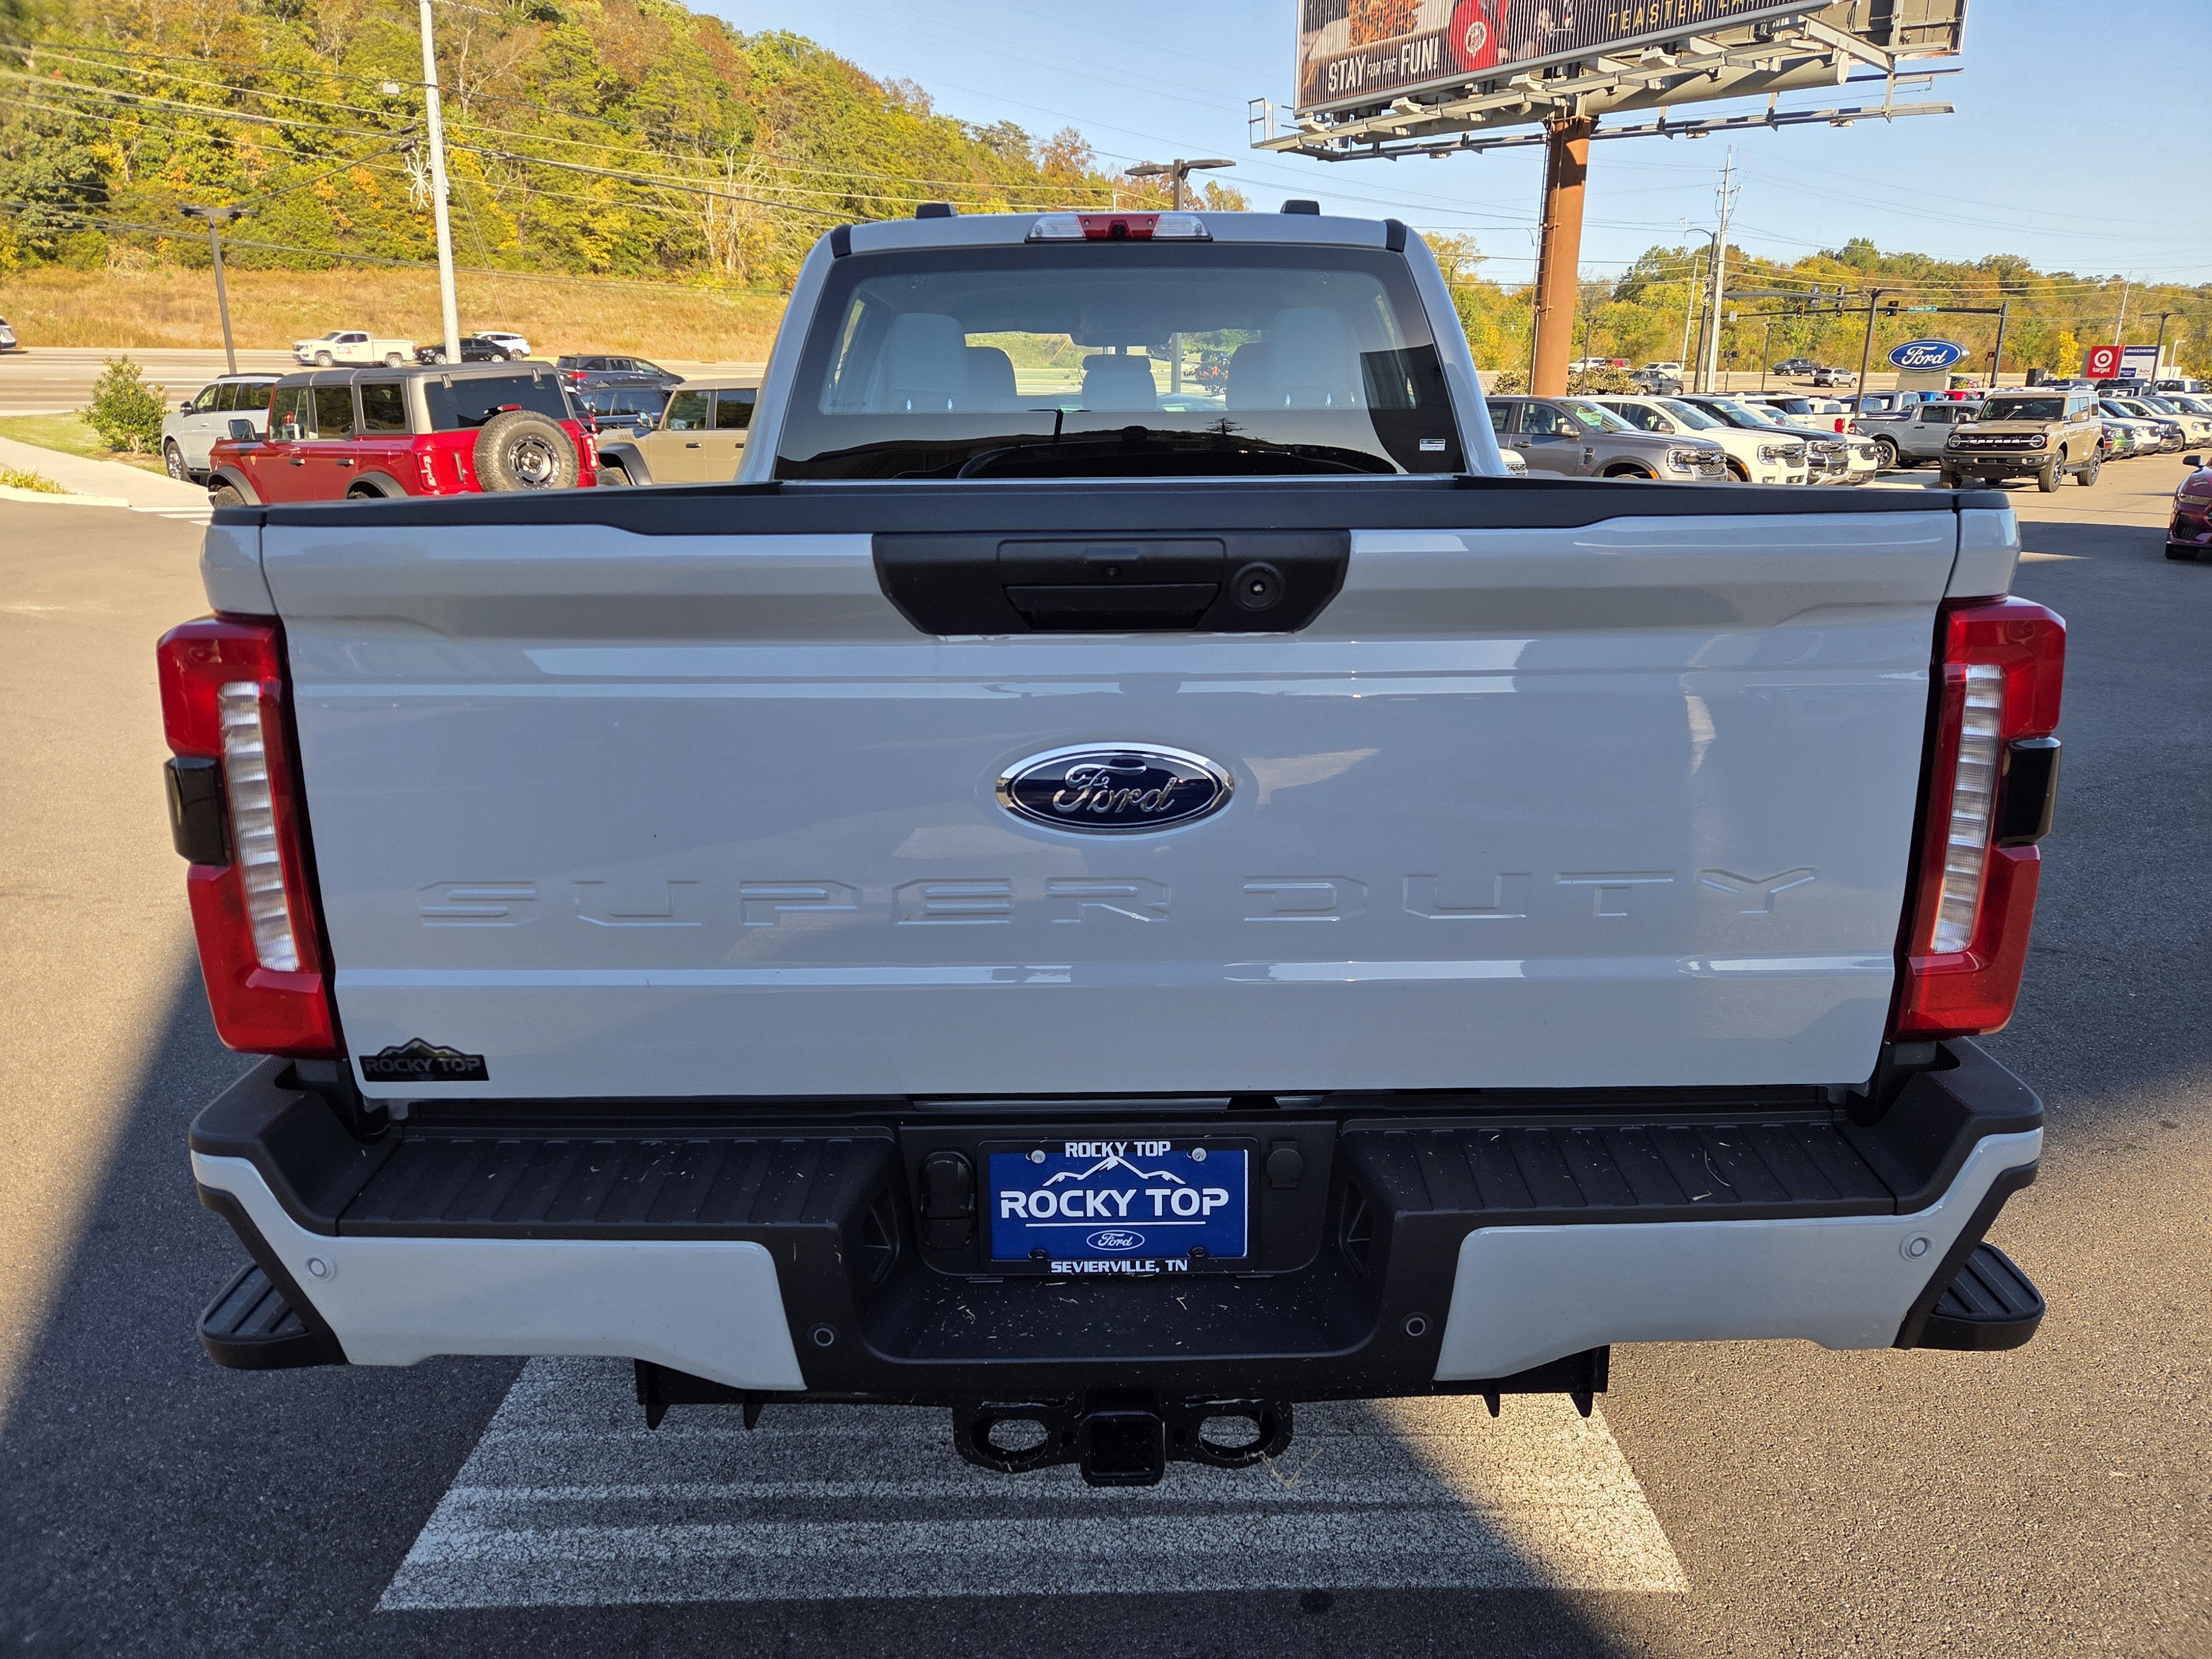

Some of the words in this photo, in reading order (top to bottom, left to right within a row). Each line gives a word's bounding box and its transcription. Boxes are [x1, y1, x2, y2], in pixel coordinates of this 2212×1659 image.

[1609, 0, 1702, 33] TEASTER
[1328, 54, 1367, 92] STAY
[1367, 62, 1381, 78] FOR
[1382, 58, 1396, 74] THE
[1401, 36, 1439, 77] FUN!
[1901, 346, 1948, 365] Ford
[1053, 763, 1178, 813] Ford
[416, 877, 1171, 928] SUPER
[1243, 865, 1818, 921] DUTY
[363, 1058, 433, 1072] ROCKY
[436, 1057, 482, 1071] TOP
[1065, 1141, 1128, 1158] ROCKY
[1134, 1141, 1171, 1157] TOP
[1000, 1189, 1137, 1219] ROCKY
[1145, 1188, 1229, 1217] TOP
[1097, 1233, 1133, 1248] Ford
[1051, 1259, 1160, 1274] SEVIERVILLE,
[1165, 1259, 1188, 1272] TN
